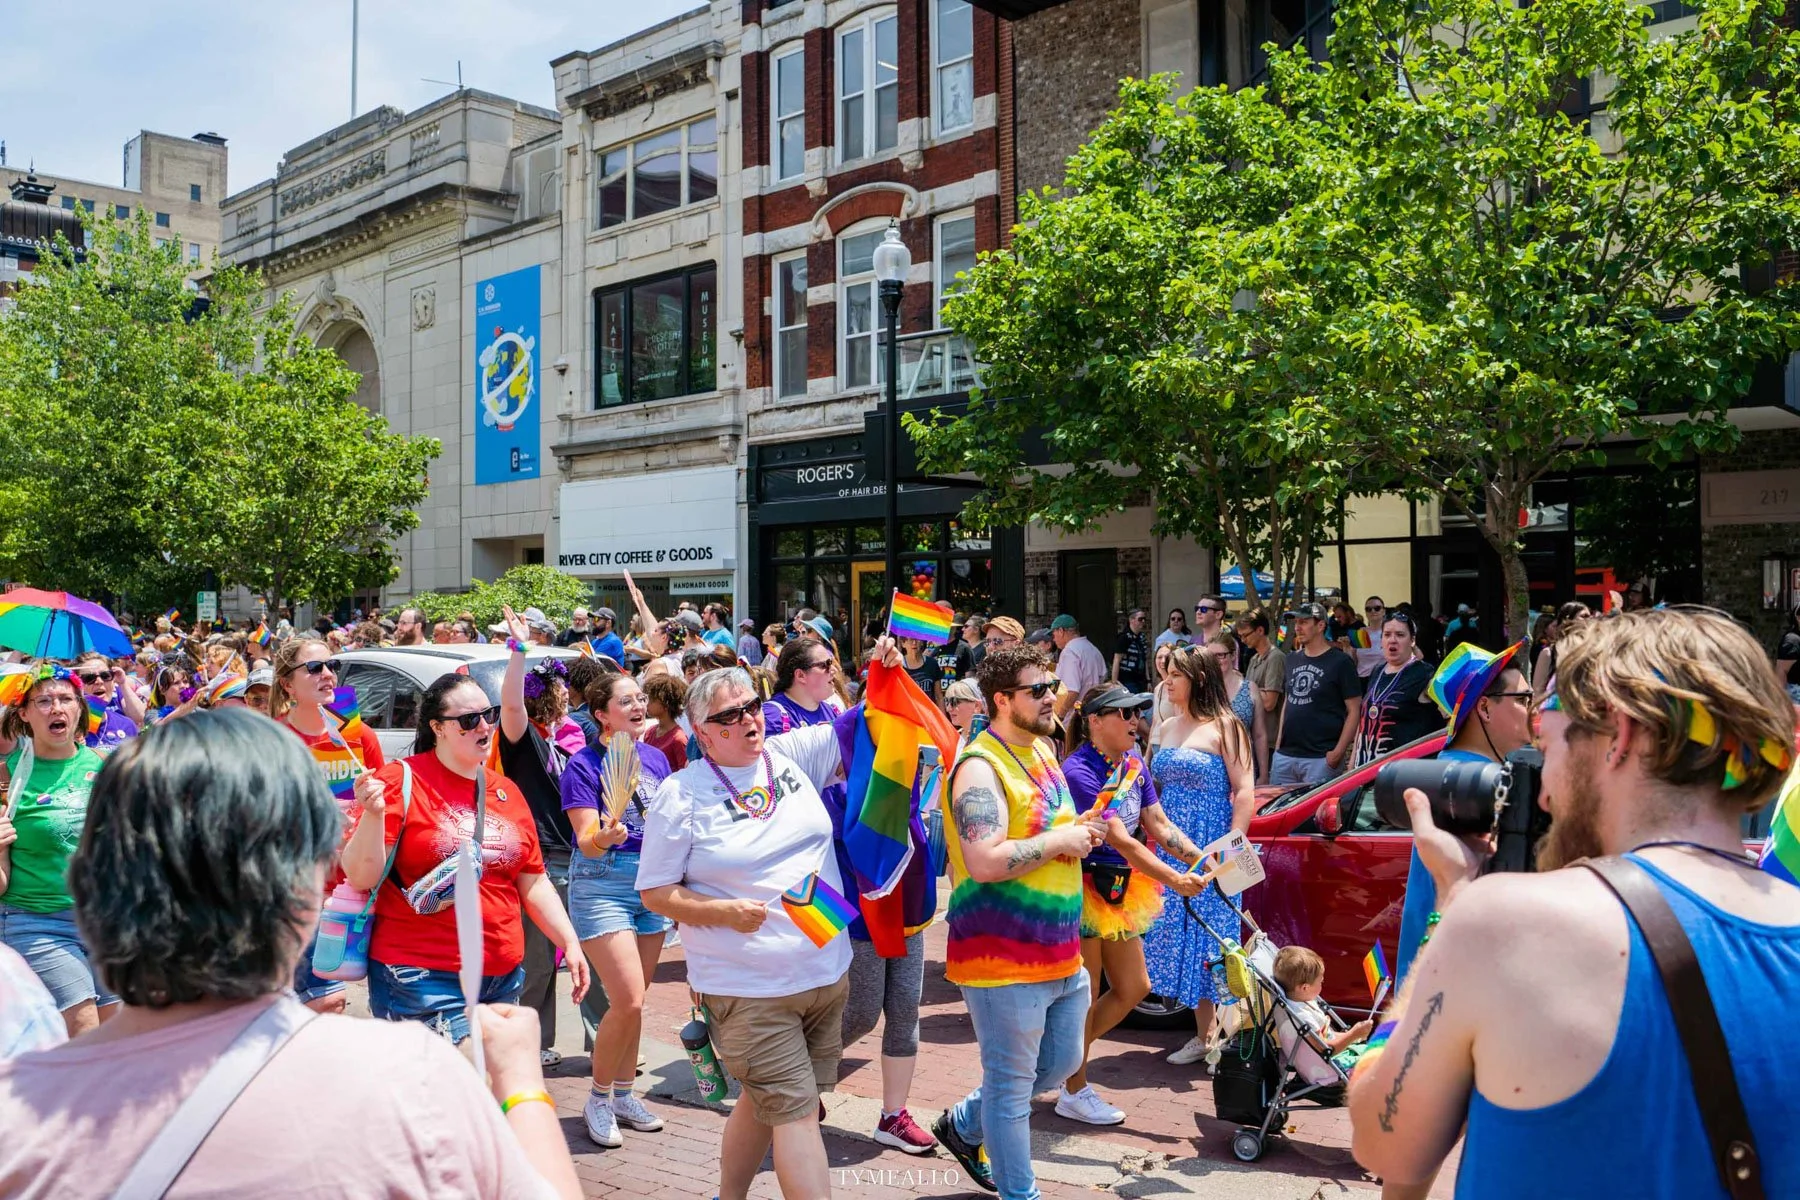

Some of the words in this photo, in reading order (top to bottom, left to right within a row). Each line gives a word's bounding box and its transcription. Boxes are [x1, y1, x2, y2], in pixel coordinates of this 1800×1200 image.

[701, 291, 709, 368] MUSEUM
[797, 463, 854, 484] ROGER'S
[838, 488, 849, 497] OF
[852, 486, 871, 496] HAIR
[872, 484, 903, 494] DESN
[1760, 488, 1789, 506] 217
[559, 554, 586, 566] RIVER
[589, 552, 612, 565] CITY
[614, 550, 653, 564] COFFEE
[655, 549, 666, 562] &
[669, 547, 713, 562] GOODS
[673, 581, 707, 589] HANDMADE
[707, 580, 729, 588] GOODS
[320, 759, 363, 781] RIDE
